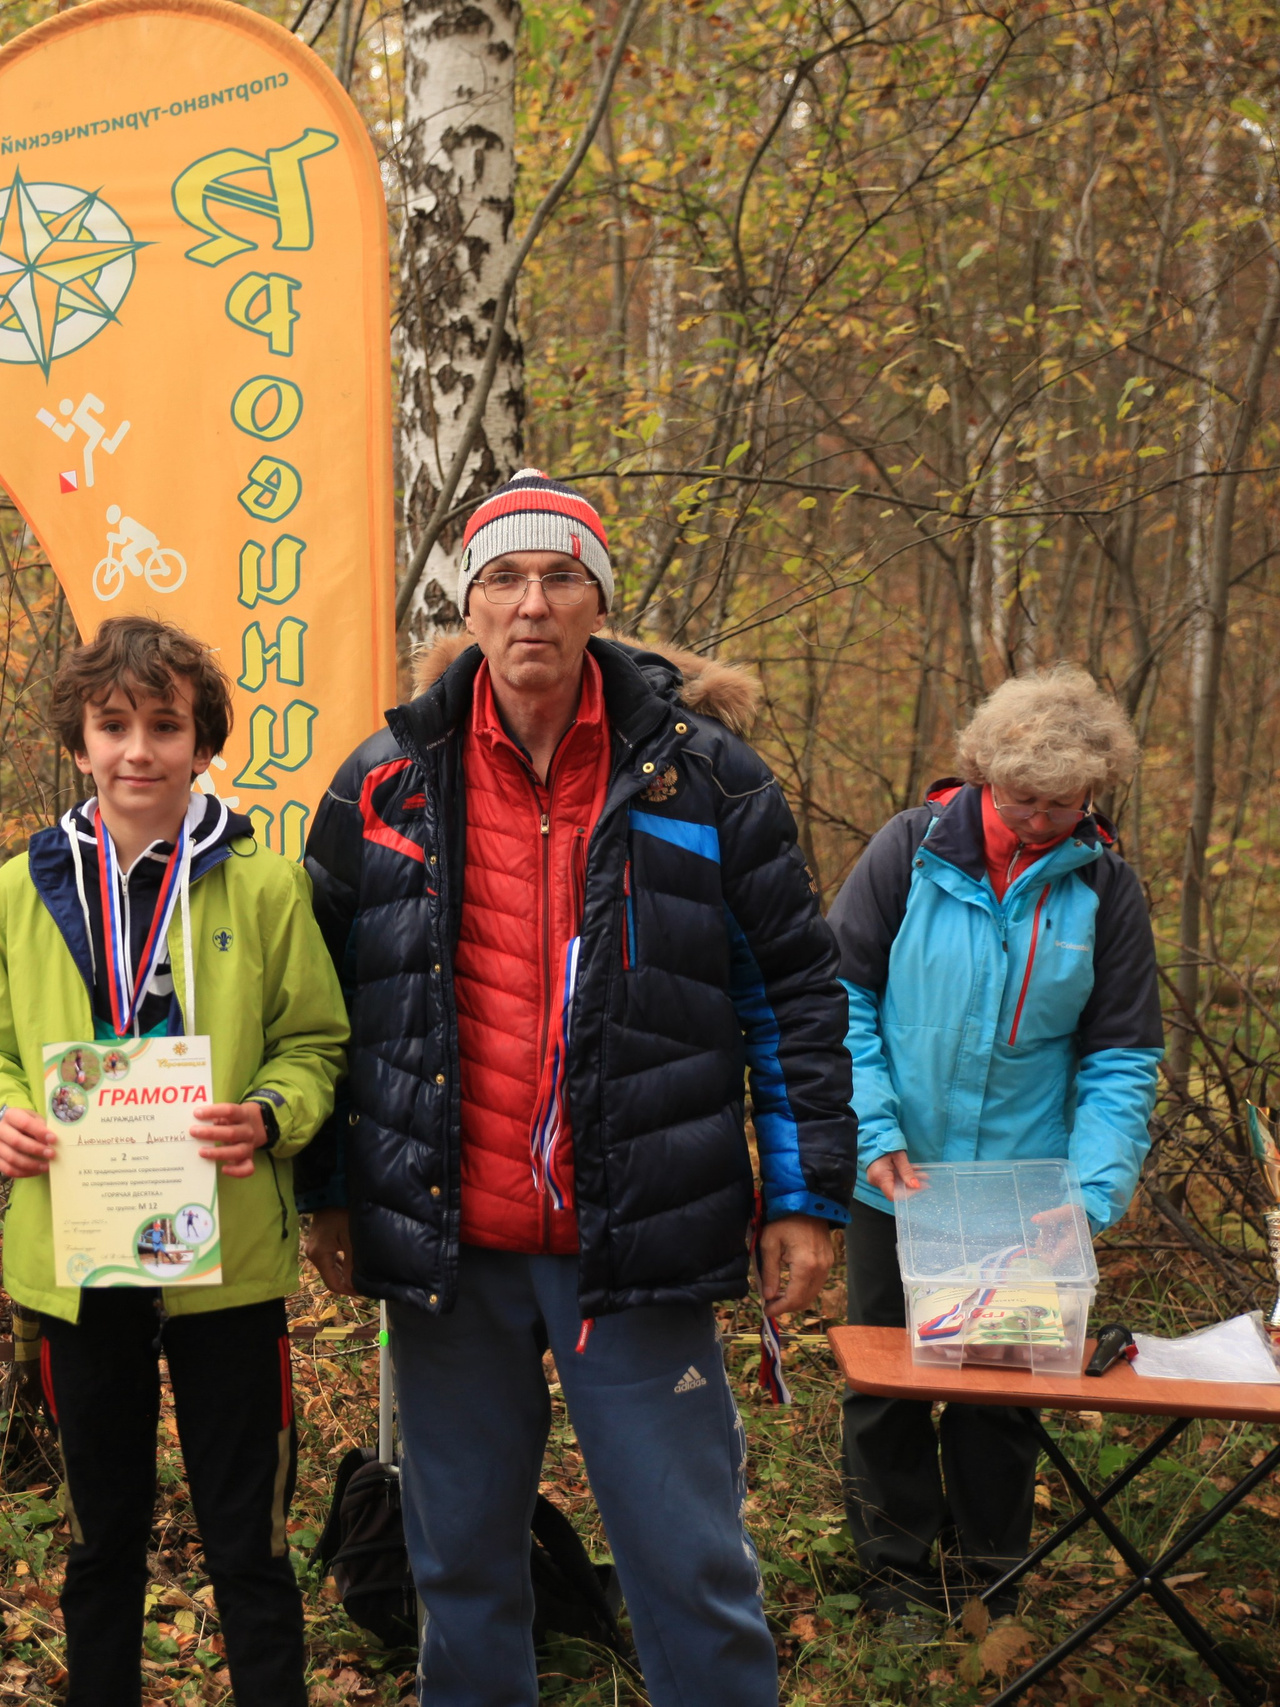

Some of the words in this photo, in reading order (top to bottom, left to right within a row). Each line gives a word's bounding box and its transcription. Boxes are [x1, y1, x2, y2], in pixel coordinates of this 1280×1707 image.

[98, 1085, 207, 1107] ГРАМОТА
[101, 1115, 155, 1123] НАГРАЖДАЕТСЯ
[122, 1153, 127, 1161] 2
[674, 1377, 707, 1393] adidas
